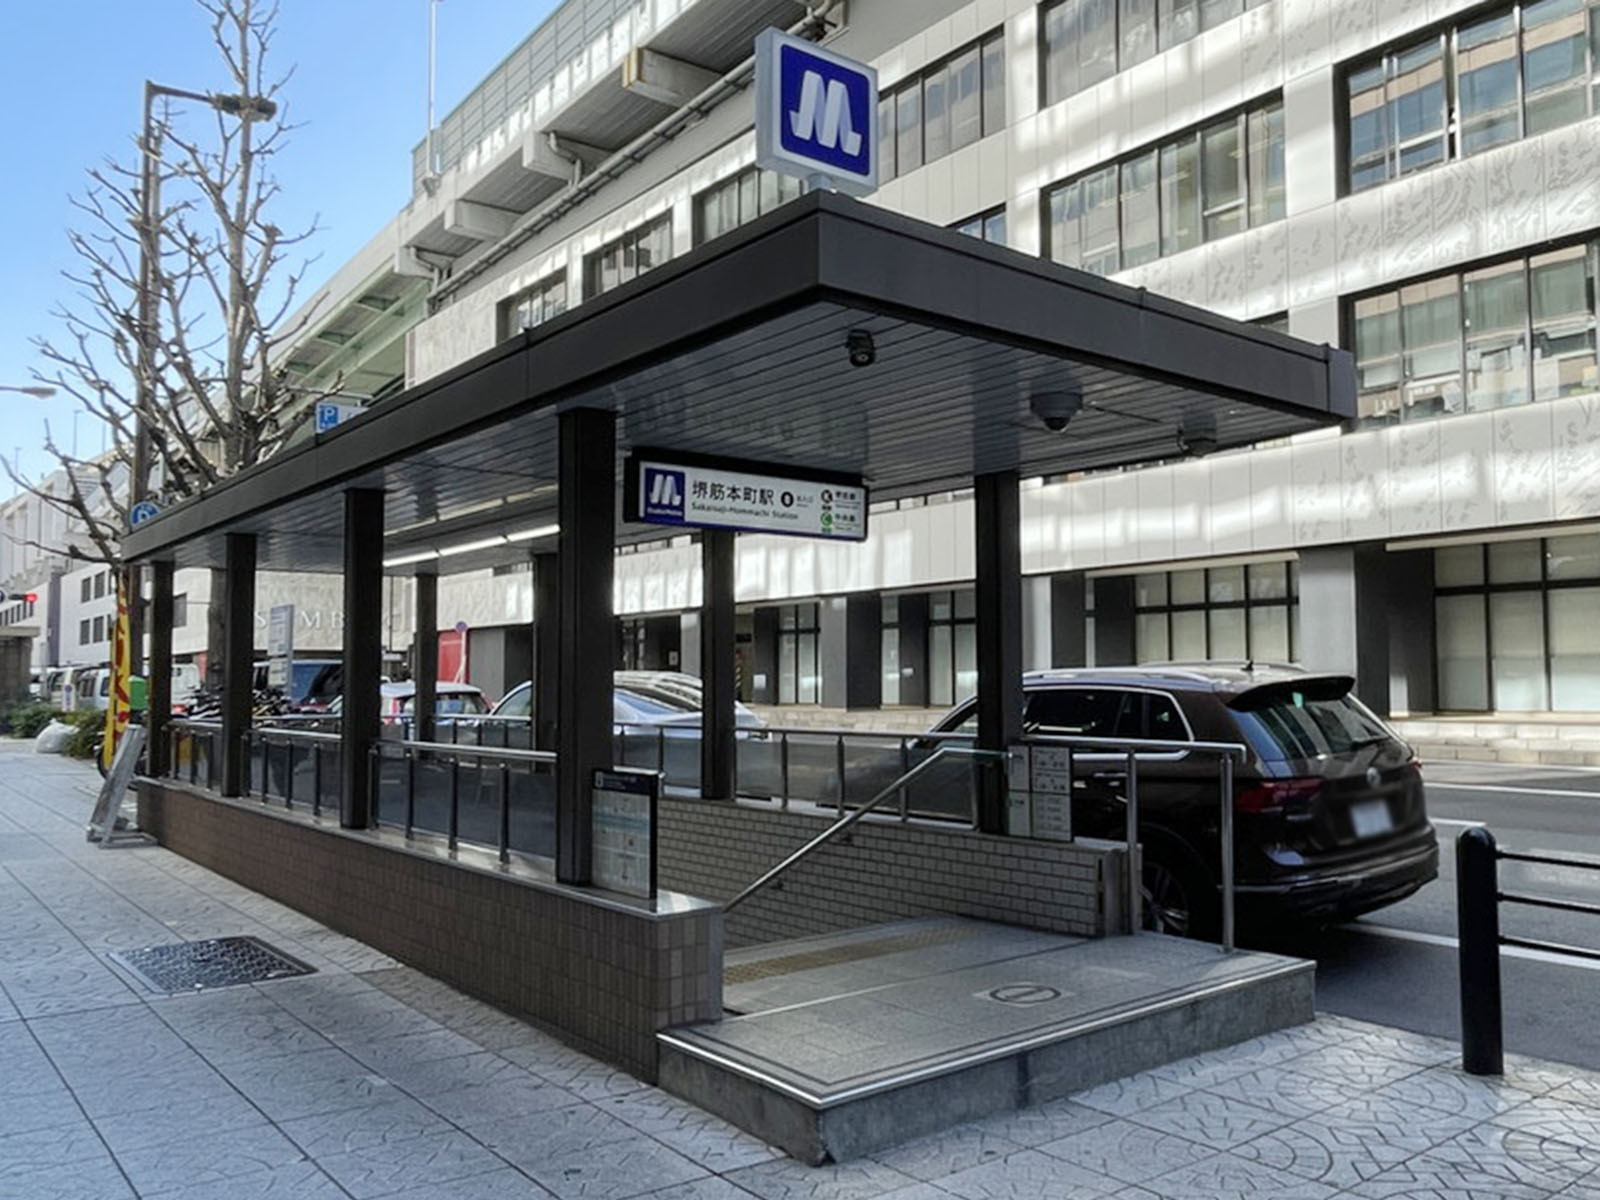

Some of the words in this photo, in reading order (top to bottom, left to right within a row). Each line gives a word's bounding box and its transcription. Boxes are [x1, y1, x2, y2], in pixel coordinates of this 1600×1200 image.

[324, 407, 336, 421] P
[691, 480, 775, 506] 堺筋本町駅
